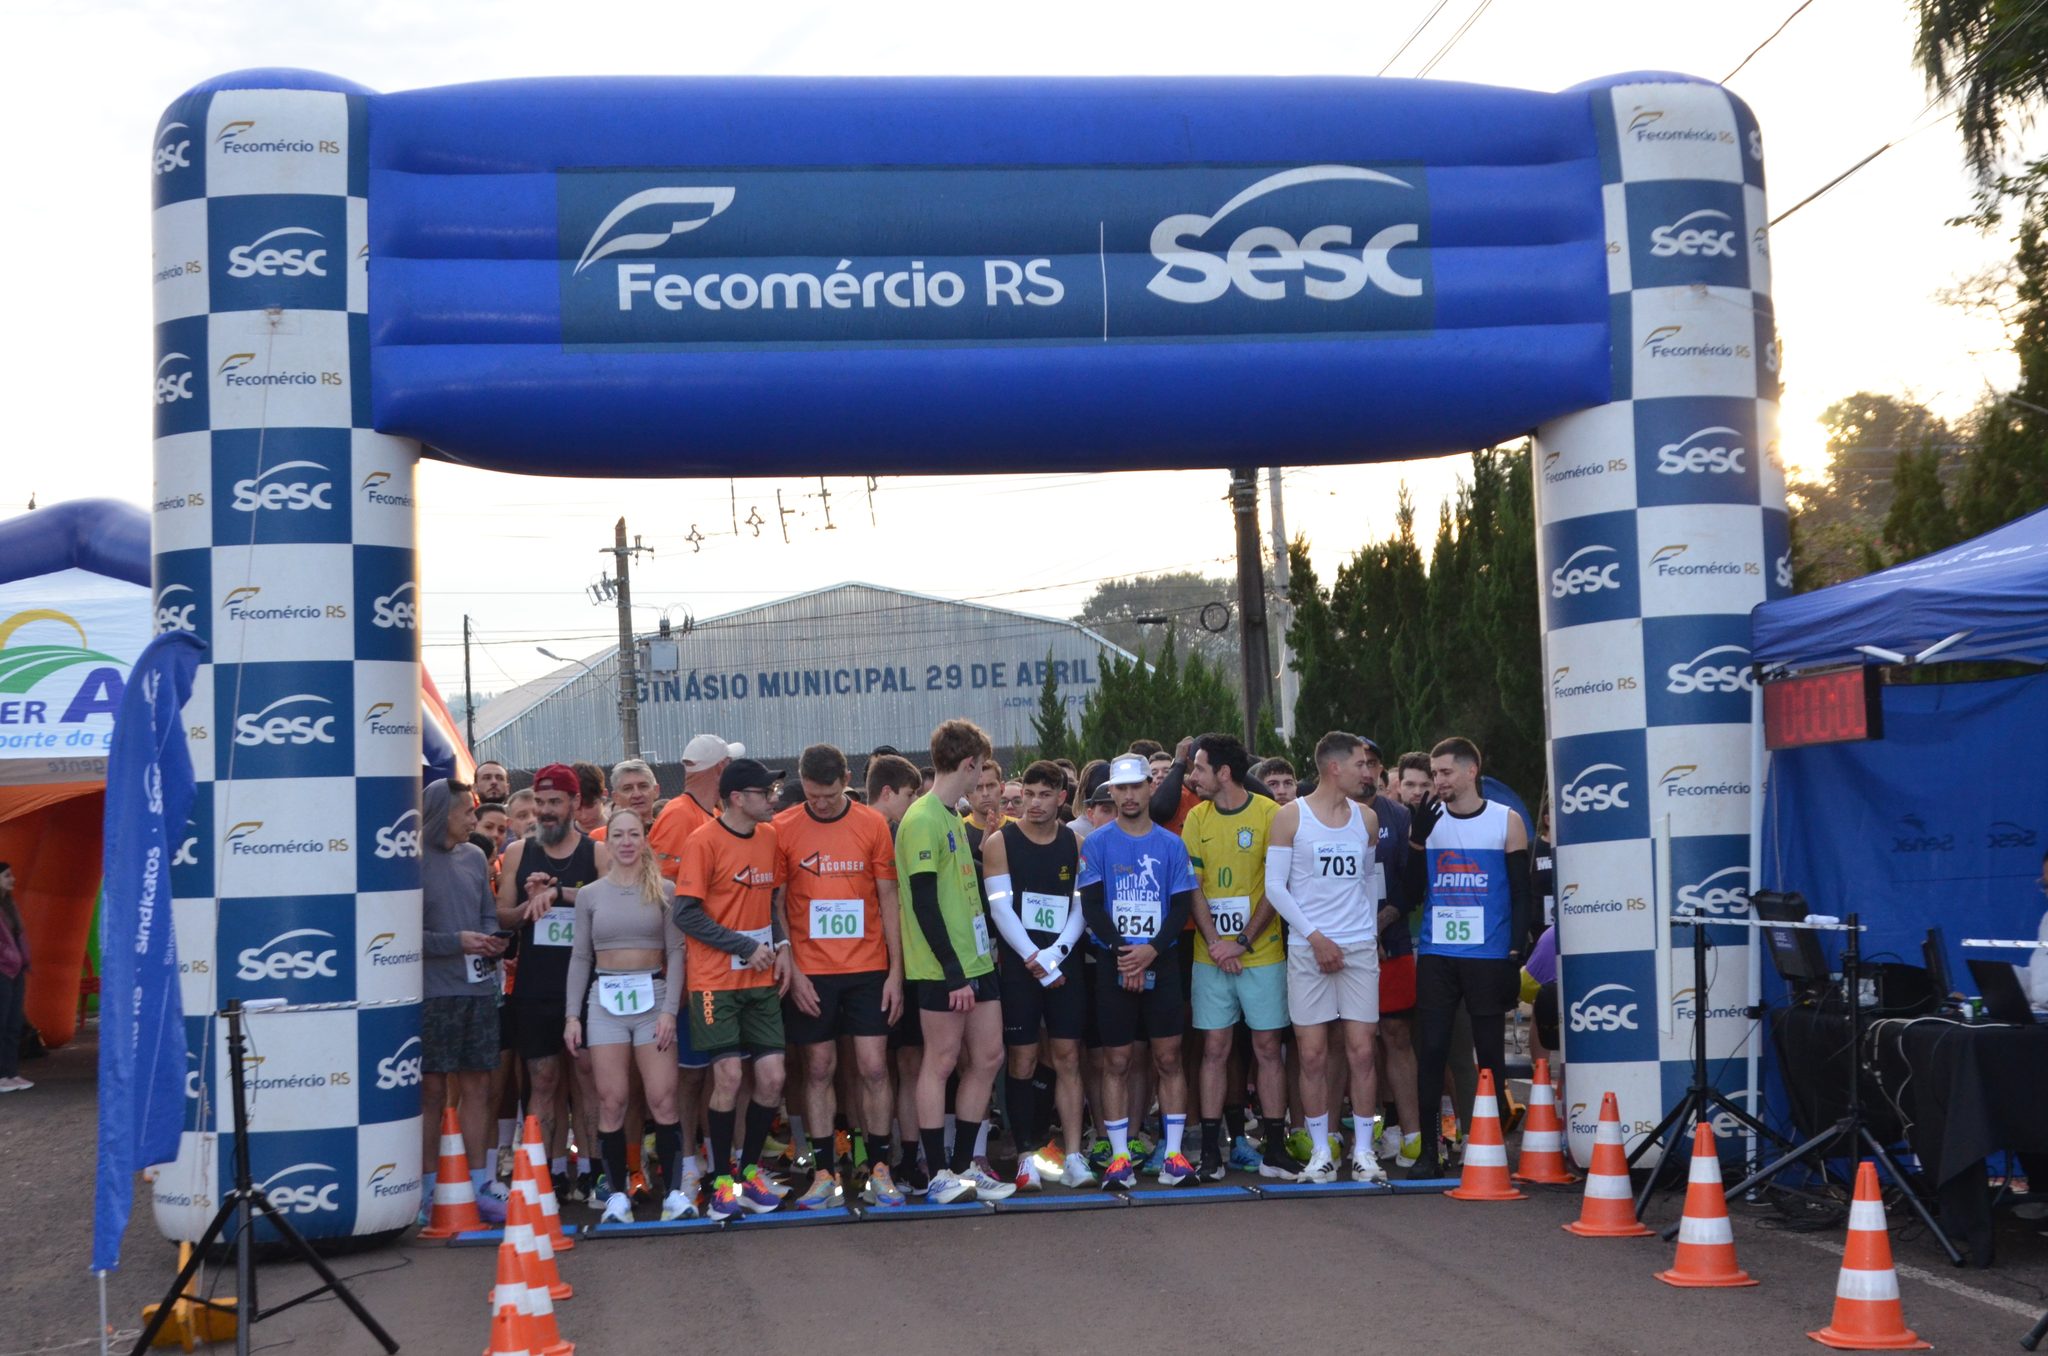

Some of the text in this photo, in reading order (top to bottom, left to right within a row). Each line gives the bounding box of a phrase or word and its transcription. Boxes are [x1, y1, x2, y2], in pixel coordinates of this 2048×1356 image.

[223, 138, 341, 155] Fecomércio RS
[1636, 127, 1717, 143] Fecomércio
[1719, 131, 1736, 146] RS
[153, 139, 191, 176] esc
[1649, 225, 1737, 259] Sesc
[185, 260, 202, 276] RS
[226, 244, 328, 279] Sesc
[1147, 213, 1424, 304] Sesc
[617, 258, 1066, 312] Fecomércio RS
[1651, 343, 1733, 359] Fecomércio
[1735, 346, 1751, 359] RS
[154, 370, 193, 406] esc
[225, 369, 343, 387] Fecomércio RS
[1656, 443, 1746, 476] Sesc
[1545, 458, 1628, 485] Fecomércio RS
[188, 493, 205, 507] RS
[230, 478, 332, 512] Sesc
[1551, 562, 1621, 599] Sesc
[1658, 561, 1742, 578] Fecomércio
[1744, 562, 1761, 576] RS
[153, 603, 196, 634] esc
[230, 604, 347, 621] Fecomércio RS
[636, 659, 1097, 704] GINÁSIO MUNICIPAL 29 DE ABRIL
[1554, 676, 1637, 700] Fecomércio RS
[1666, 662, 1753, 694] Sesc
[65, 729, 95, 747] da
[190, 726, 208, 740] RS
[234, 713, 335, 747] Sesc
[1561, 781, 1630, 815] Sesc
[1667, 781, 1751, 798] Fecomércio
[233, 837, 350, 856] Fecomércio RS
[1319, 855, 1357, 877] 703
[1217, 866, 1233, 889] 10
[1432, 872, 1489, 888] JAIME
[134, 845, 162, 956] Sindicatos
[1563, 898, 1623, 916] Fecomércio
[1626, 897, 1647, 912] RS
[1676, 884, 1751, 916] Ses
[818, 913, 858, 935] 160
[1034, 907, 1055, 929] 46
[1117, 914, 1156, 936] 854
[547, 921, 575, 943] 64
[1445, 920, 1471, 941] 85
[191, 959, 210, 974] RS
[236, 947, 338, 982] Sesc
[614, 989, 638, 1012] 11
[703, 990, 715, 1025] didas
[1570, 1000, 1639, 1033] Sesc
[1676, 1004, 1749, 1020] Feomérc
[243, 1071, 351, 1090] ecomércio RS
[1572, 1120, 1655, 1135] Fecomo RS
